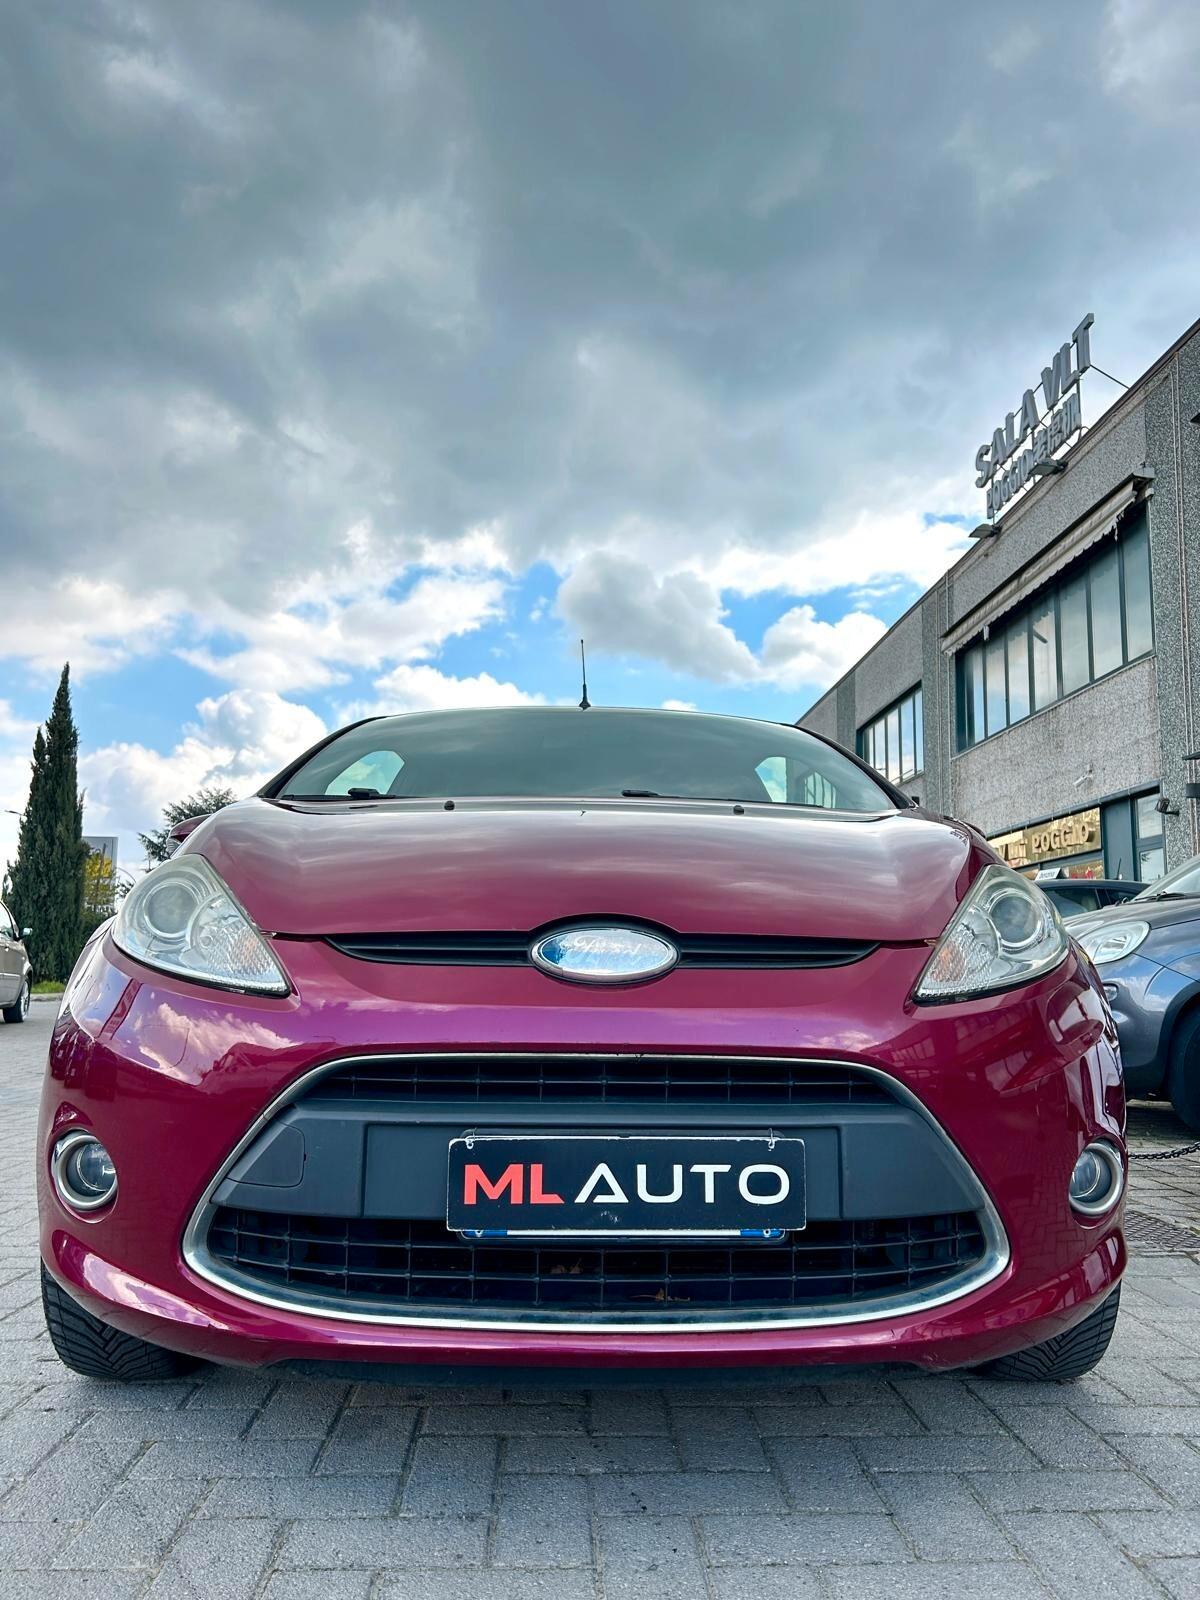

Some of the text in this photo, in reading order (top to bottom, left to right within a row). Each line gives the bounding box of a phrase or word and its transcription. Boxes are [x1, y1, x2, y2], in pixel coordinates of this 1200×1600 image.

[975, 313, 1095, 488] SALA VLT
[986, 449, 1034, 519] POGGIO
[1032, 822, 1089, 854] POGGIO
[464, 1162, 790, 1205] ML AUTO
